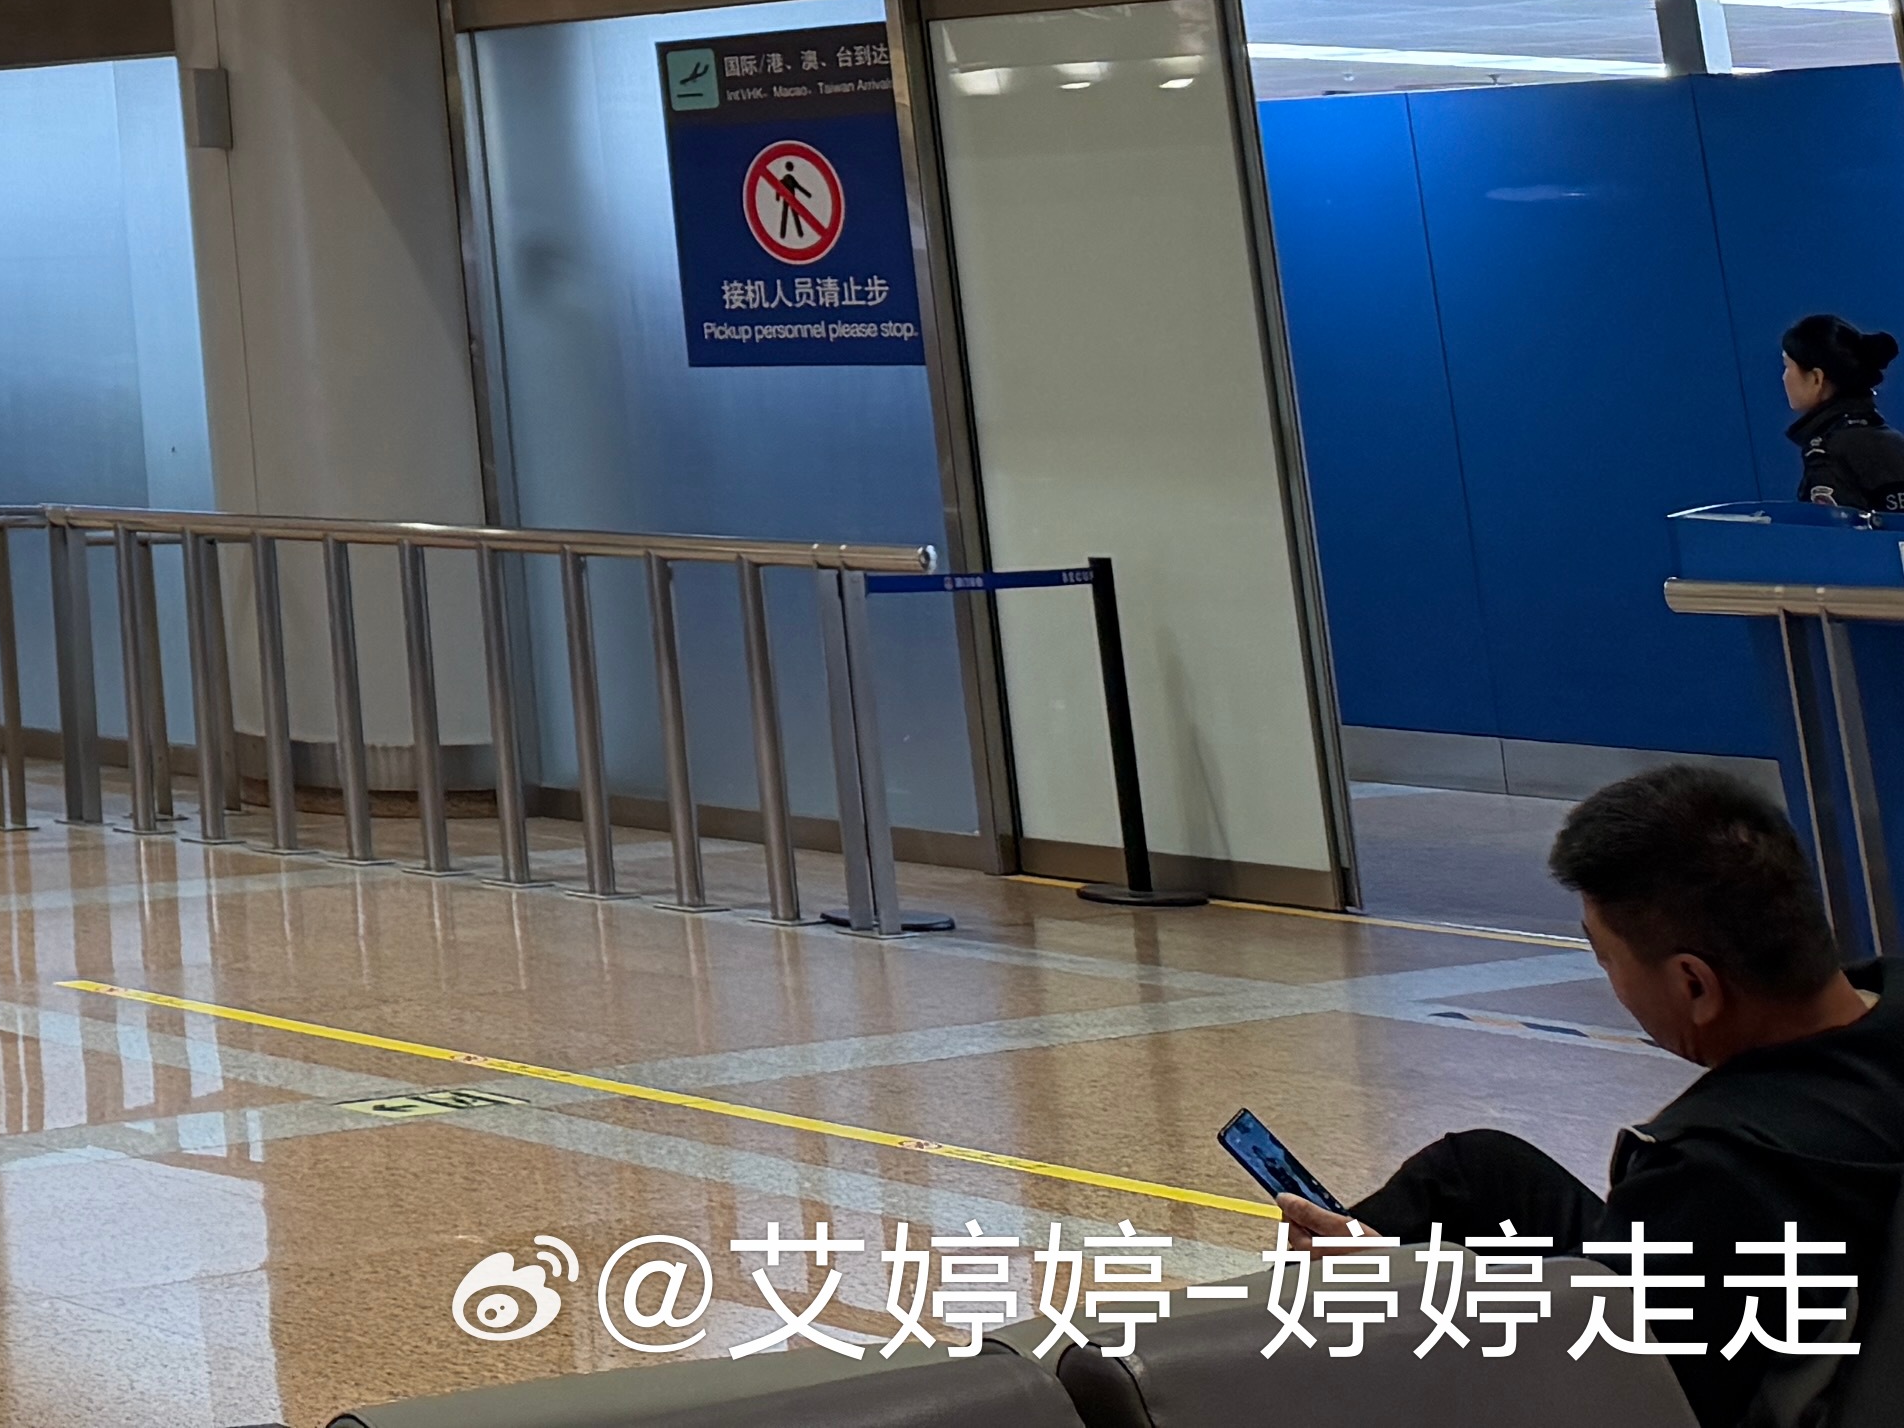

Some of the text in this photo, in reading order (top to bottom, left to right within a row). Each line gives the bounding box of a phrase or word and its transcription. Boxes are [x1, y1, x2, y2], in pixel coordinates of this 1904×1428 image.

[817, 81, 856, 95] Taiwan
[721, 274, 890, 310] 接机人员请止步
[704, 321, 752, 342] Pickup
[755, 320, 827, 343] personnel
[829, 319, 878, 343] please
